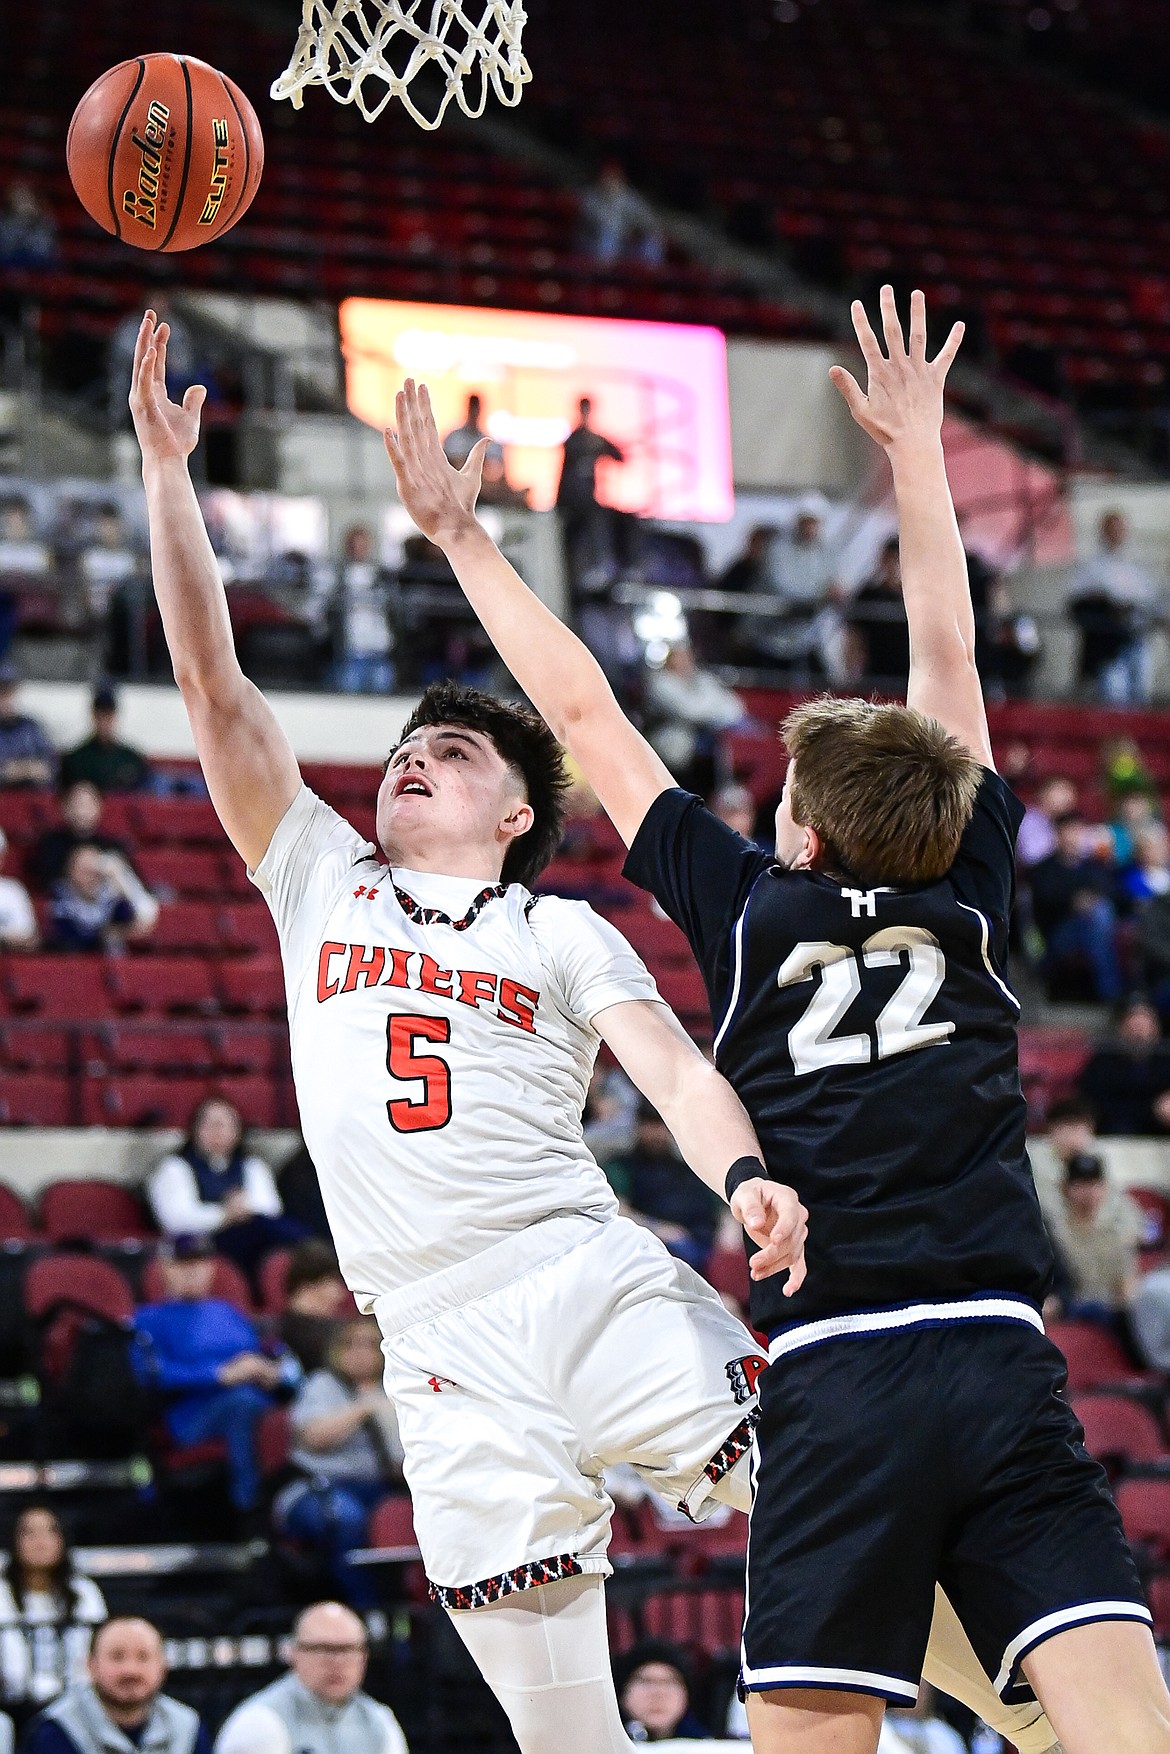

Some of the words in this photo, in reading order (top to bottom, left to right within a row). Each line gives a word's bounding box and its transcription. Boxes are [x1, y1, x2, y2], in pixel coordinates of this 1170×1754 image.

[123, 100, 170, 230] Baden
[160, 128, 176, 212] PERFECTION
[197, 119, 229, 225] ELITE
[317, 941, 540, 1034] CHIEFS
[777, 925, 956, 1076] 22
[386, 1012, 453, 1134] 5
